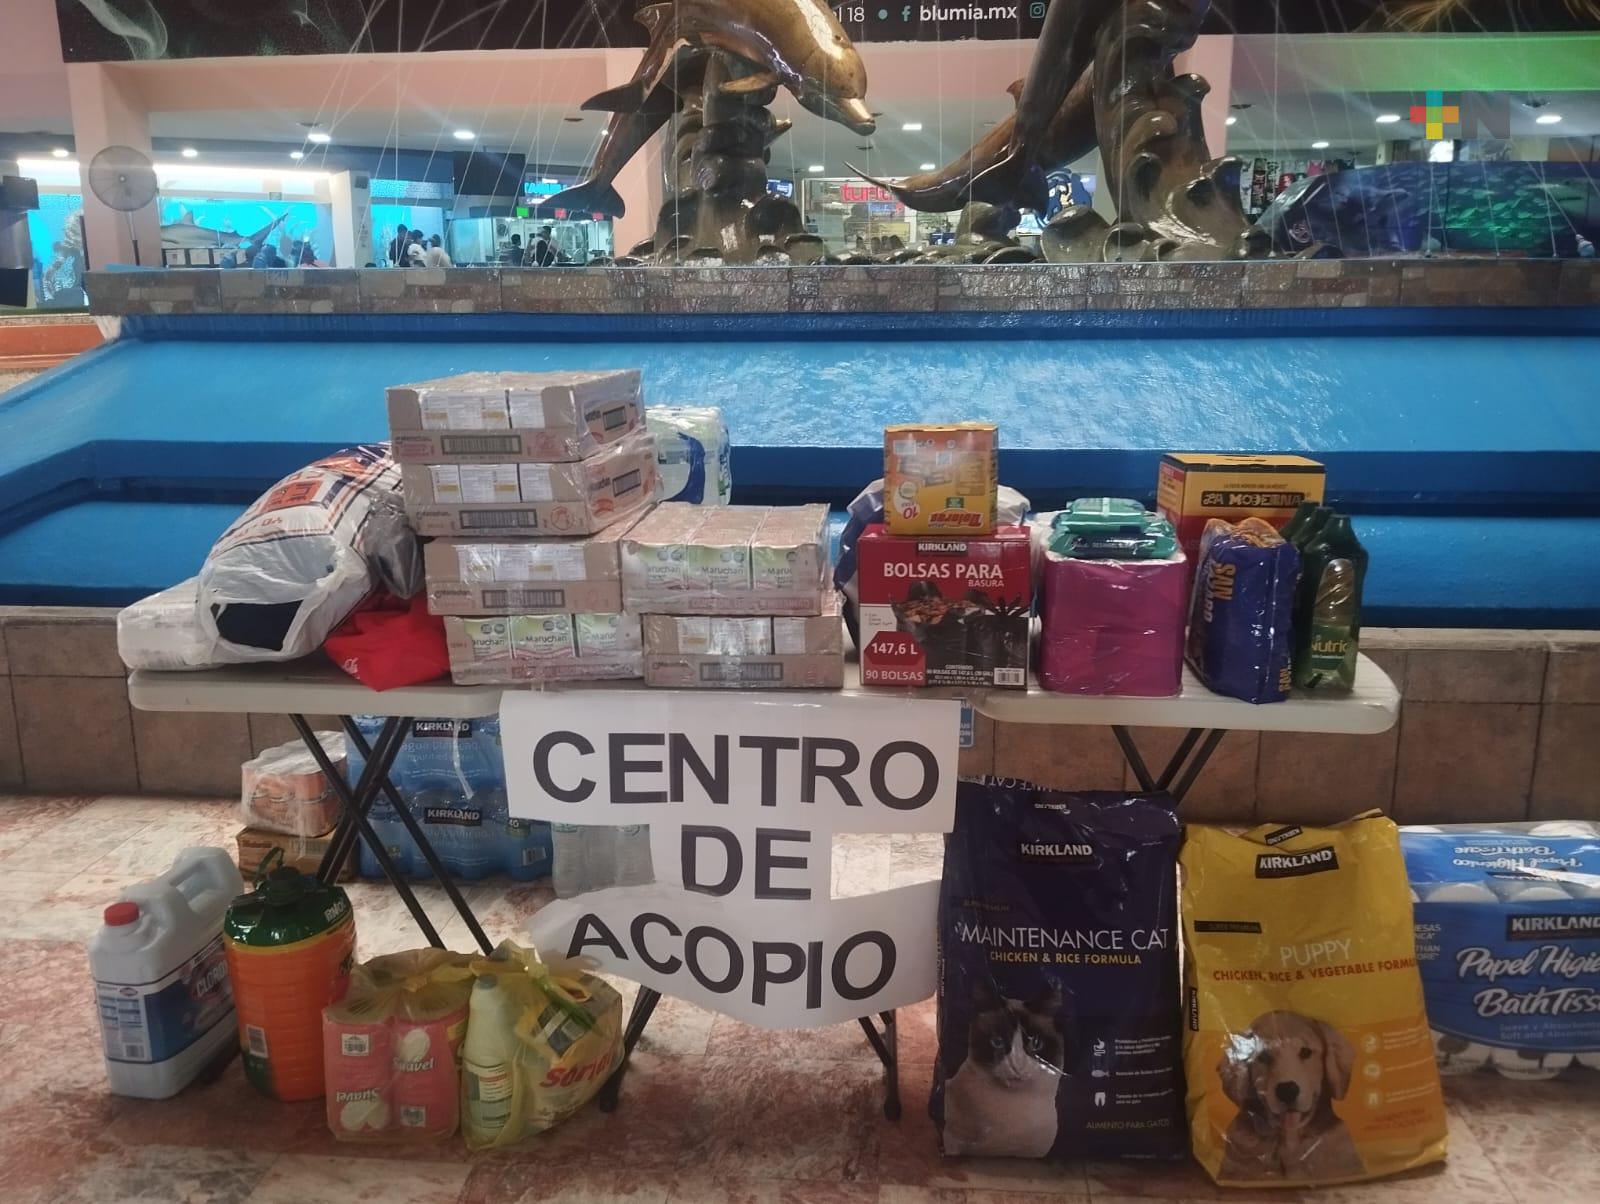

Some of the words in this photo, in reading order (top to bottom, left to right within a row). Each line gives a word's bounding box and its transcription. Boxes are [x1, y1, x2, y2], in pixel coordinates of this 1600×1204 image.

[849, 7, 865, 22] 18
[920, 5, 1017, 21] blumia.mx
[918, 543, 967, 551] KIRKLAND
[702, 566, 743, 575] Maruchan
[884, 562, 950, 578] BOLSAS
[955, 564, 1003, 579] PARA
[968, 579, 1004, 587] BASURA
[1213, 562, 1236, 600] SAN
[472, 637, 505, 646] aruchan
[526, 634, 567, 644] Maruchan
[872, 642, 907, 655] 147,6
[911, 643, 918, 655] L
[866, 670, 878, 680] 90
[882, 670, 923, 681] BOLSAS
[416, 722, 470, 731] KIRKLAND
[533, 730, 940, 811] CENTRO
[427, 809, 480, 820] KIRKLAND
[1020, 843, 1092, 856] KIRKLAND
[681, 824, 811, 900] DE
[1259, 849, 1332, 869] KIRKLAND
[961, 924, 1123, 950] MAINTENANCE
[1131, 928, 1168, 950] CAT
[991, 952, 1038, 963] CHICKEN
[1042, 953, 1051, 963] &
[1056, 953, 1081, 964] RICE
[1085, 954, 1141, 965] FORMULA
[1280, 938, 1352, 967] PUPPY
[566, 912, 897, 1009] ACOPIO
[1456, 947, 1539, 982] Papel
[1213, 968, 1266, 981] CHICKEN,
[1269, 971, 1291, 982] RICE
[1296, 970, 1304, 980] &
[1310, 963, 1374, 979] VEGETABLE
[1474, 987, 1548, 1017] Bath
